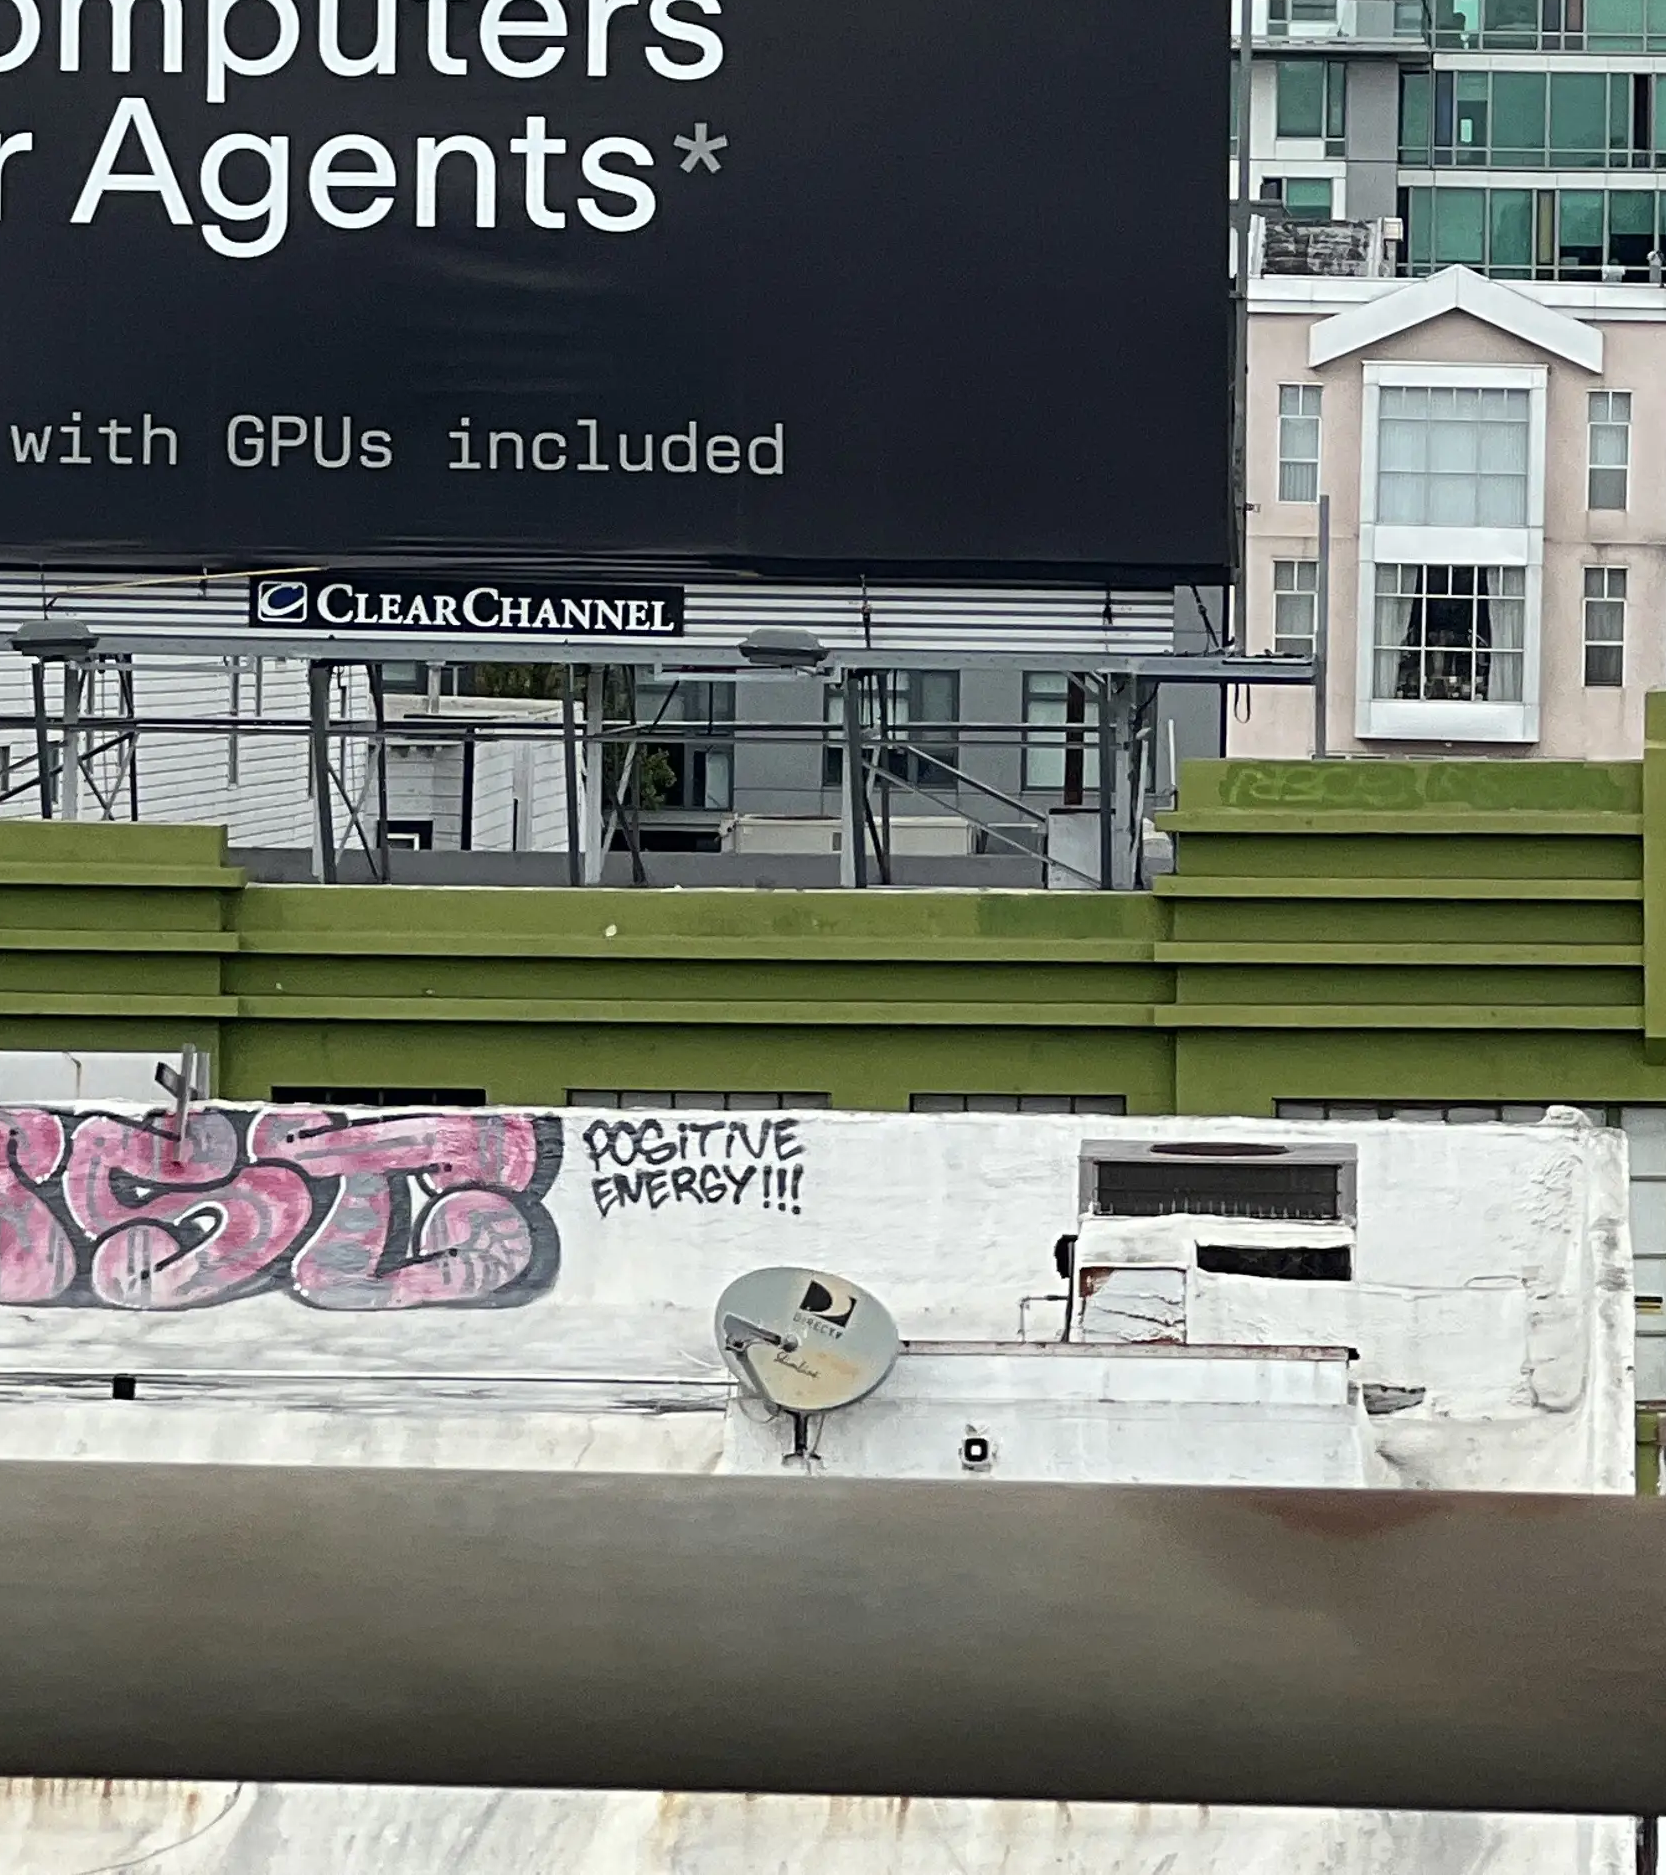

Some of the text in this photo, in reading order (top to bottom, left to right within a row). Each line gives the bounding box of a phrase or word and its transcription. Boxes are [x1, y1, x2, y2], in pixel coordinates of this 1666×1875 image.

[10, 411, 177, 467] with
[227, 414, 393, 470] GPUs
[447, 417, 785, 476] included
[591, 1163, 804, 1218] ENERGY!!!
